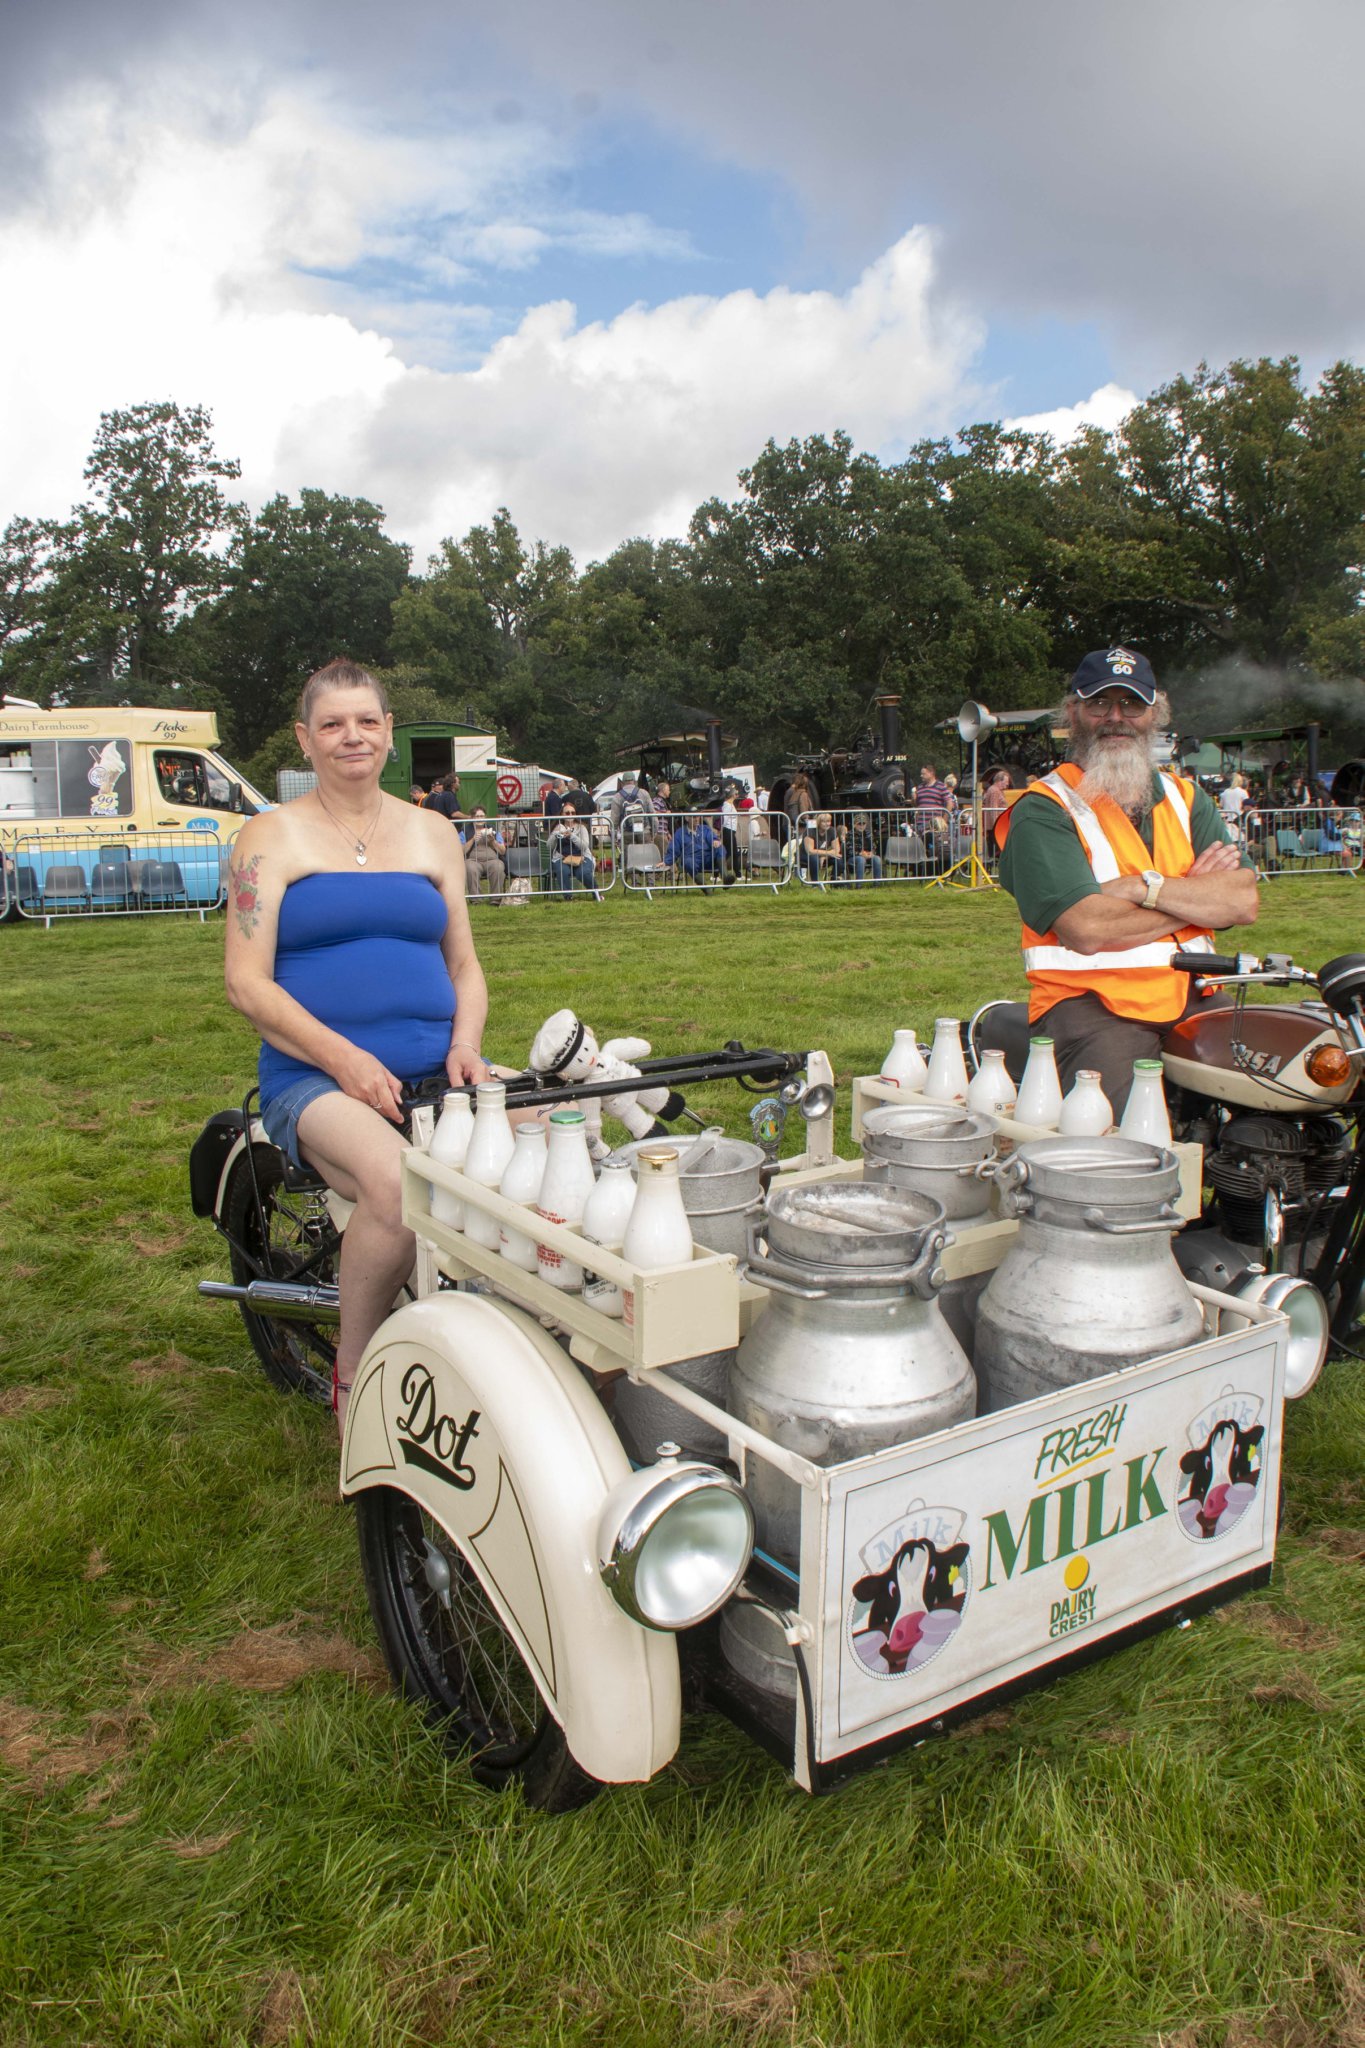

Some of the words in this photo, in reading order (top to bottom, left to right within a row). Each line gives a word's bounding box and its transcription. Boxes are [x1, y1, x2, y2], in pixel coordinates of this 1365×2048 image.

[1112, 664, 1133, 675] 60
[32, 720, 89, 731] Farmhouse
[161, 732, 176, 740] 99
[97, 795, 114, 806] 99
[396, 1362, 481, 1484] Dot
[1033, 1402, 1128, 1480] FRESH
[1196, 1400, 1254, 1443] Milk
[978, 1446, 1169, 1592] MILK
[872, 1516, 953, 1568] Milk
[1049, 1606, 1097, 1638] CREST
[1050, 1583, 1098, 1625] DAIRY
